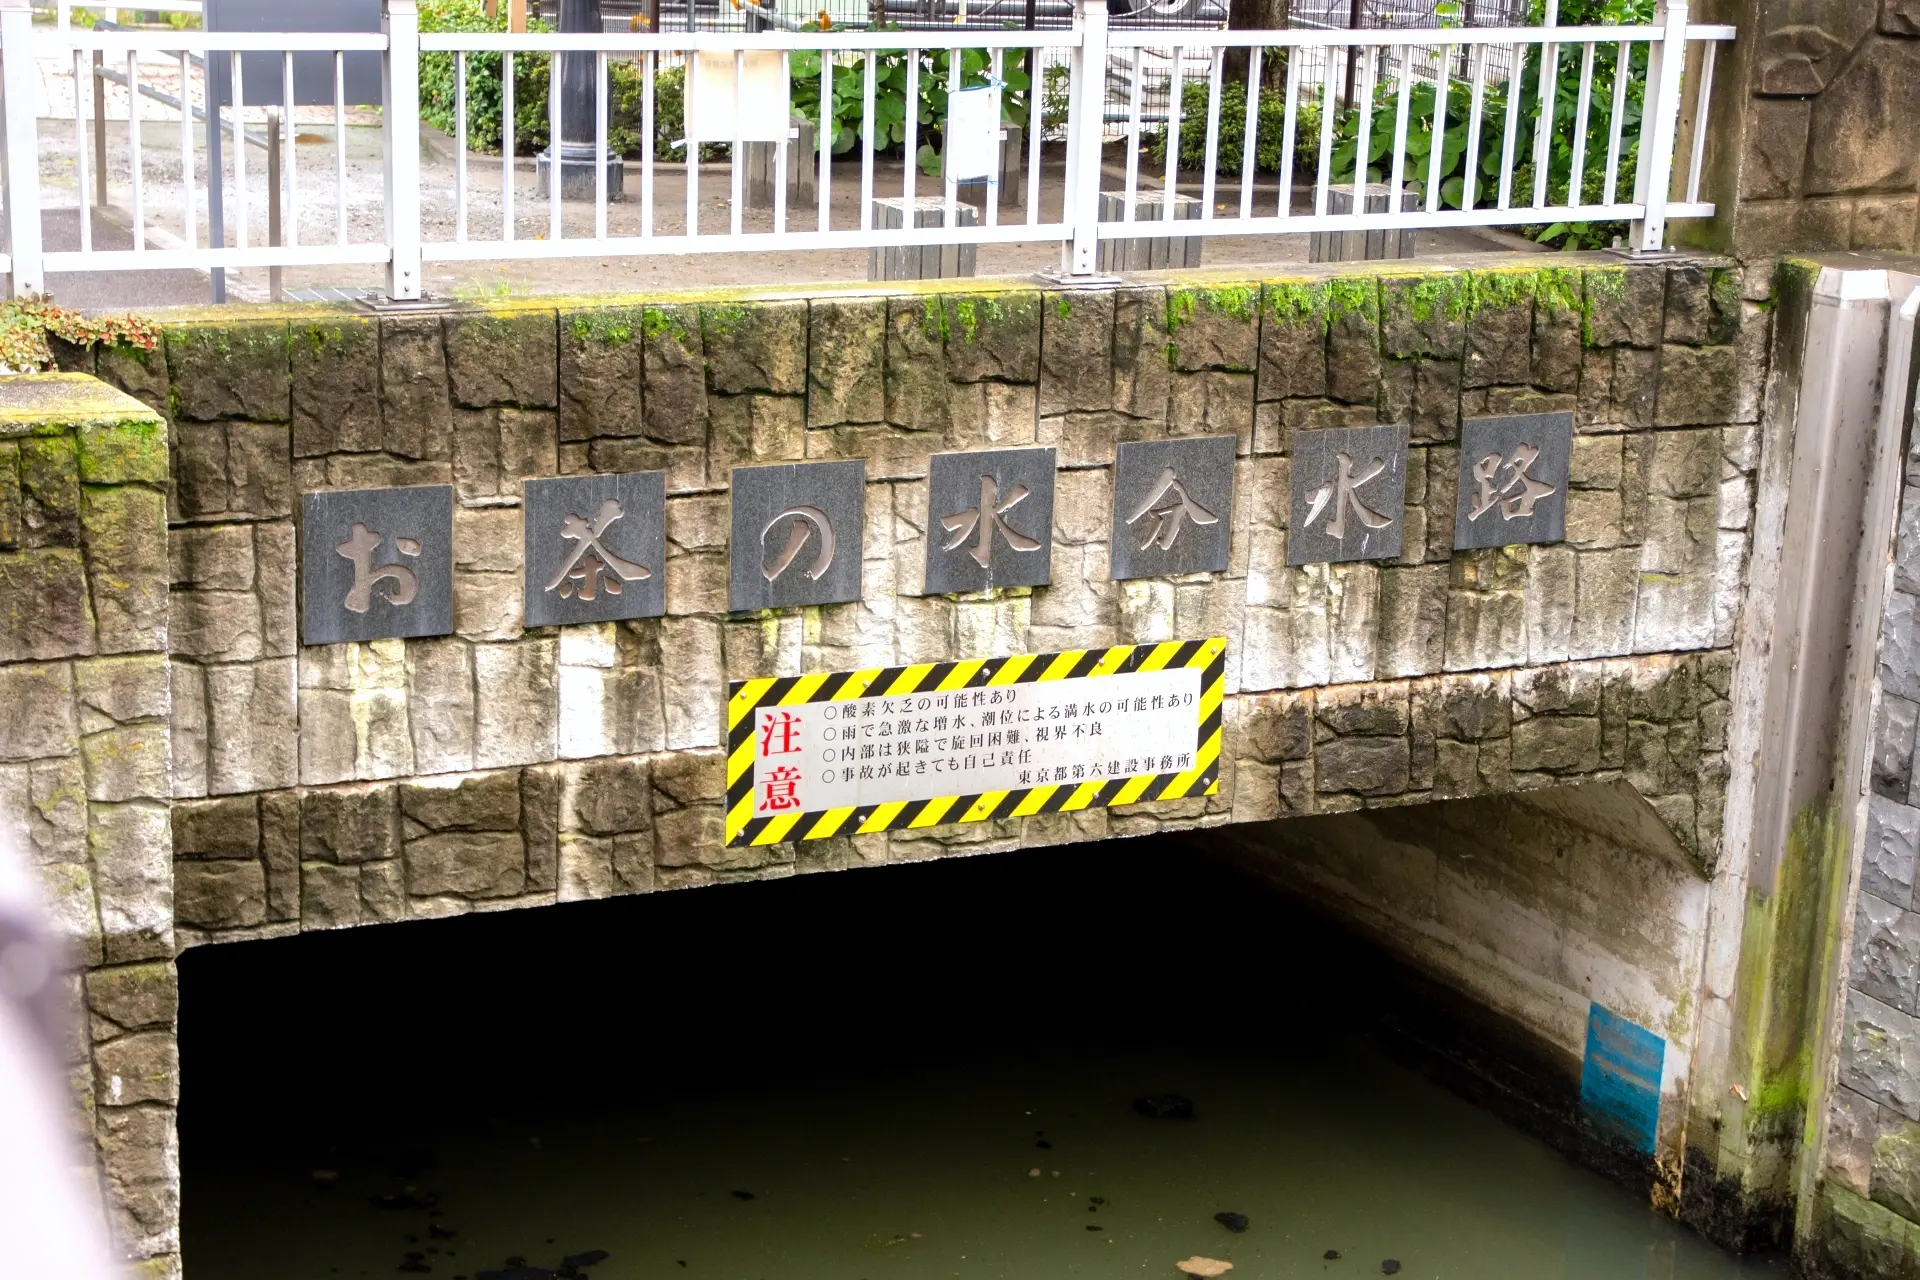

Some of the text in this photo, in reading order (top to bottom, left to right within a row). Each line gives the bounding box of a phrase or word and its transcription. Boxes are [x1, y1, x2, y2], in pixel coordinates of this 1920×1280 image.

[337, 442, 1556, 613] お茶の水分水路
[759, 711, 802, 812] 注意
[1018, 752, 1191, 785] 東京都第六建設事務所
